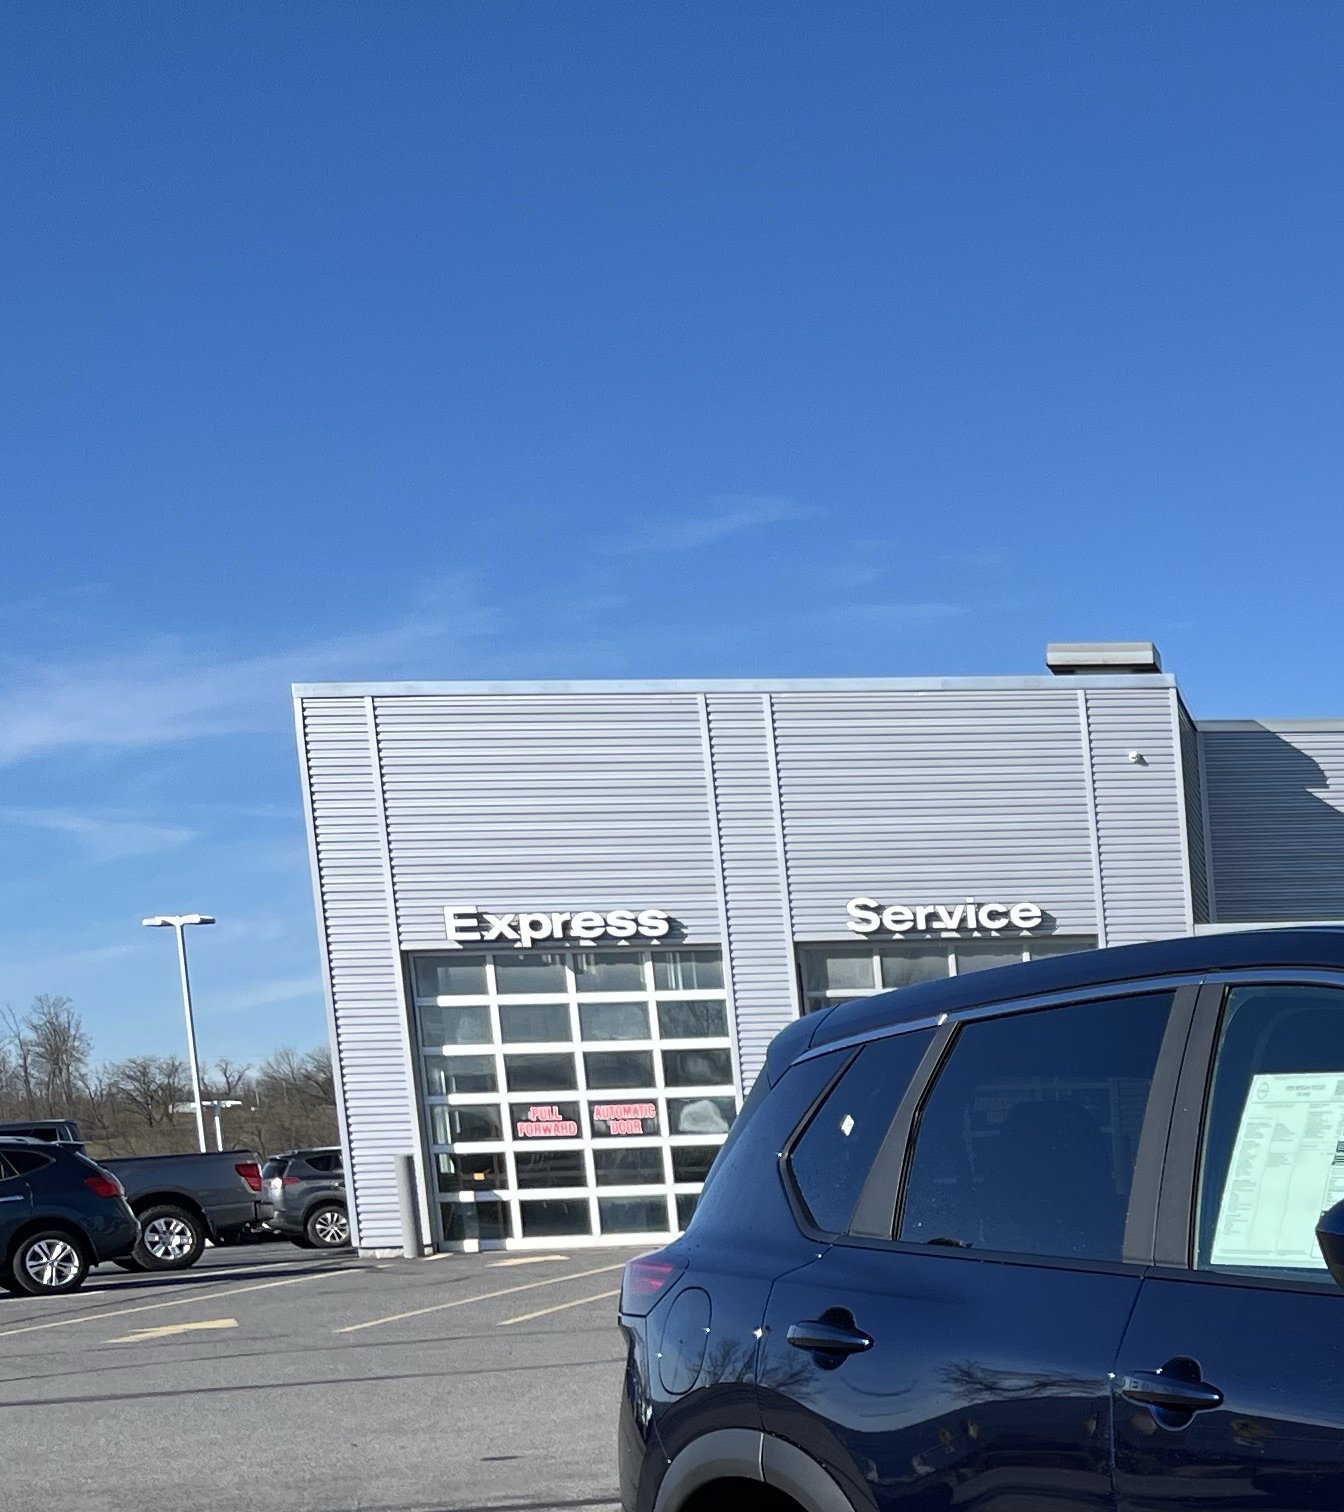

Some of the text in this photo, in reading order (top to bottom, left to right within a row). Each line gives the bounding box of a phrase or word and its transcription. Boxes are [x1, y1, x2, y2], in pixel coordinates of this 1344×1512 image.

[846, 896, 1042, 933] Service
[443, 904, 670, 948] Express
[529, 1105, 562, 1121] PULL
[593, 1103, 656, 1120] AUTOMATIC
[517, 1120, 578, 1137] FORWARD
[609, 1119, 643, 1135] DOOR
